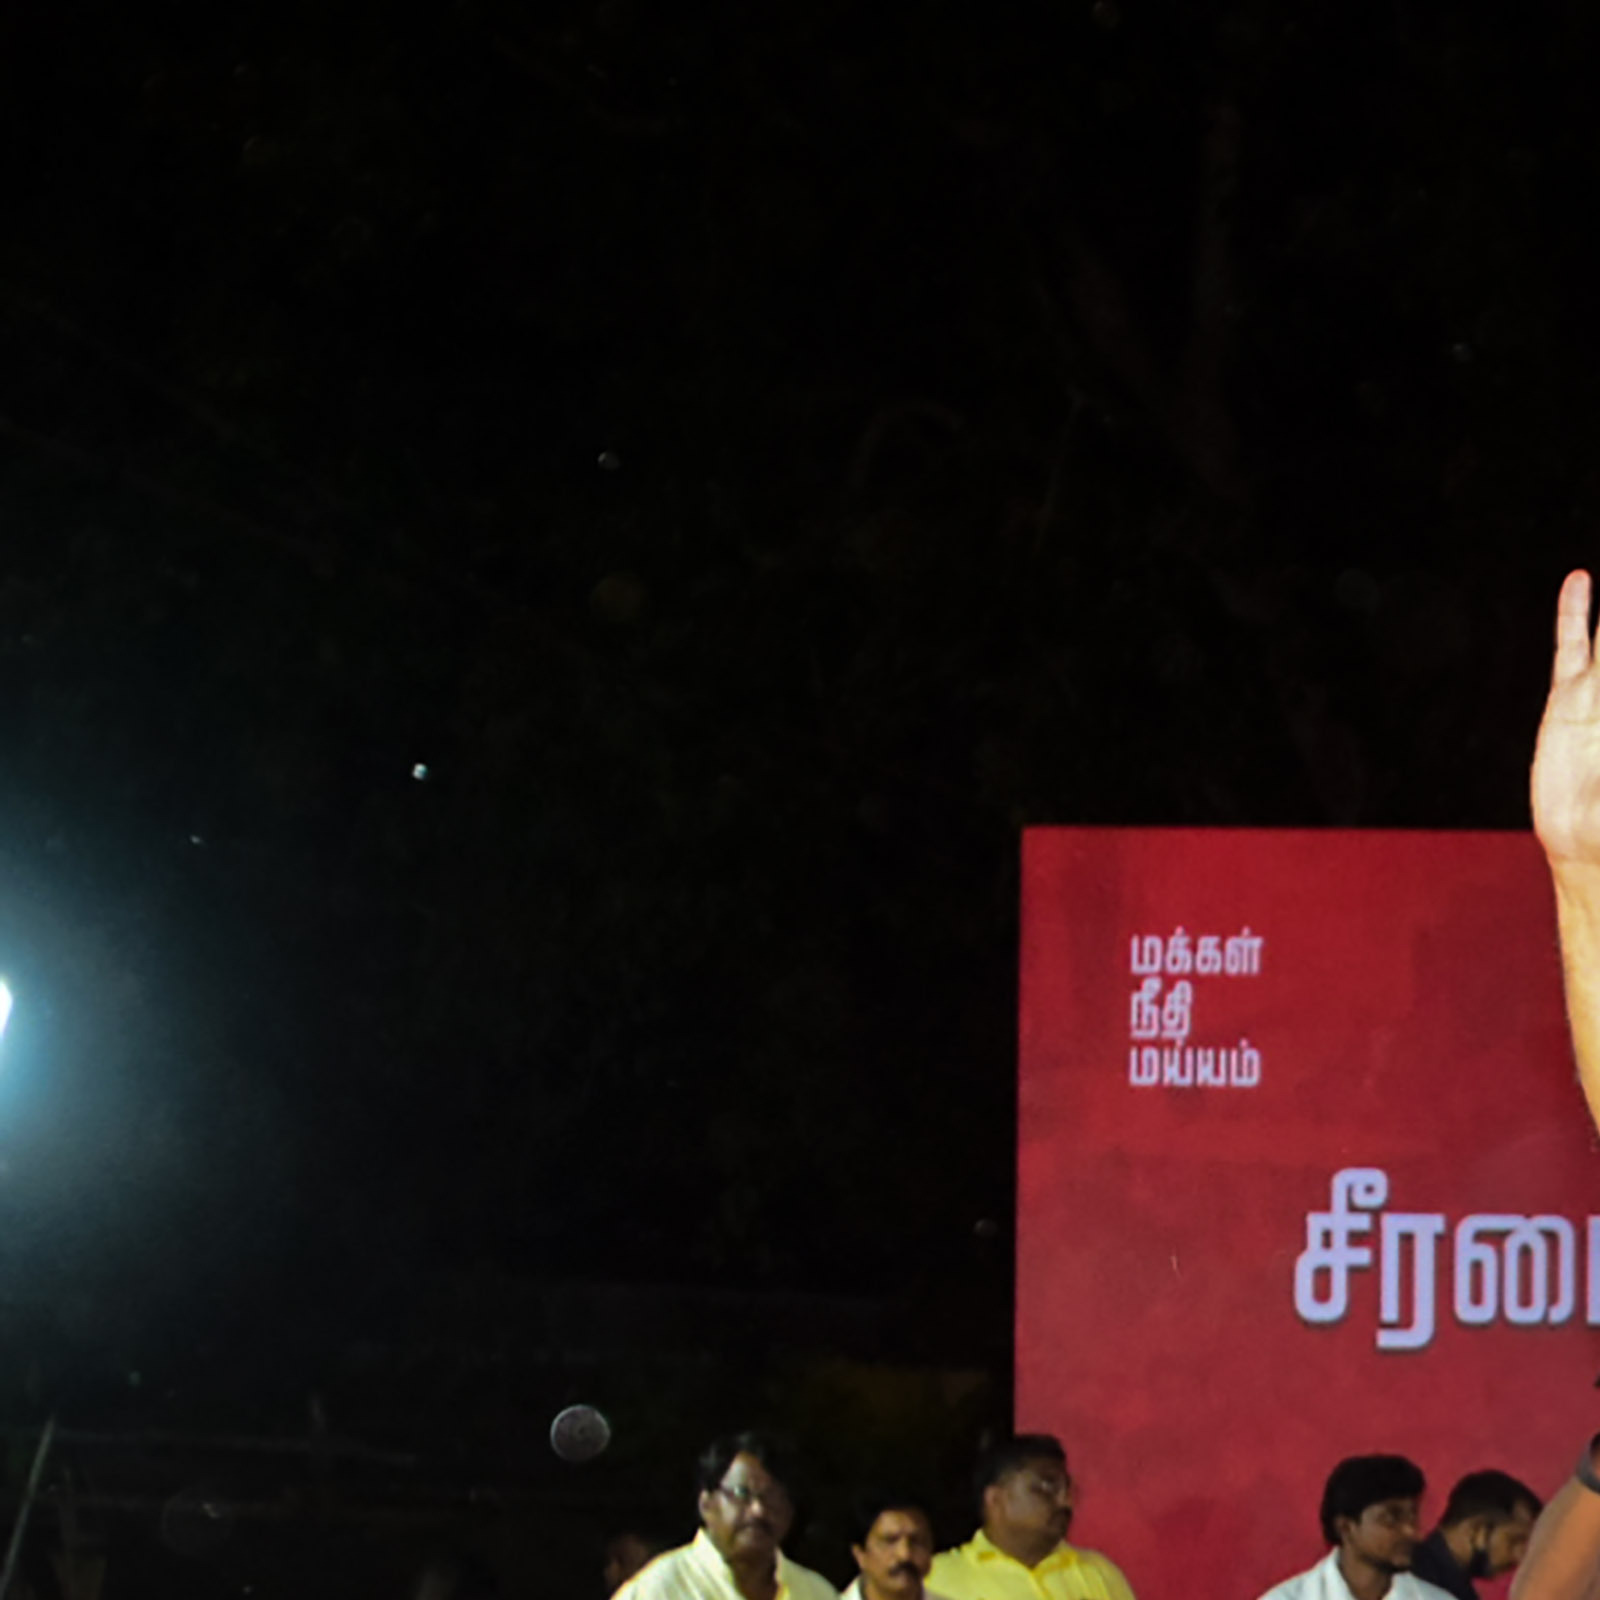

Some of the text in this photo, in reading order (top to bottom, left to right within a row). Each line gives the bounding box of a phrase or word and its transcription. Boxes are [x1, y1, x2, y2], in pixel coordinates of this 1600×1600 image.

[1130, 925, 1264, 976] மக்கள்
[1130, 976, 1193, 1039] நீதி
[1129, 1037, 1262, 1088] மய்யம்
